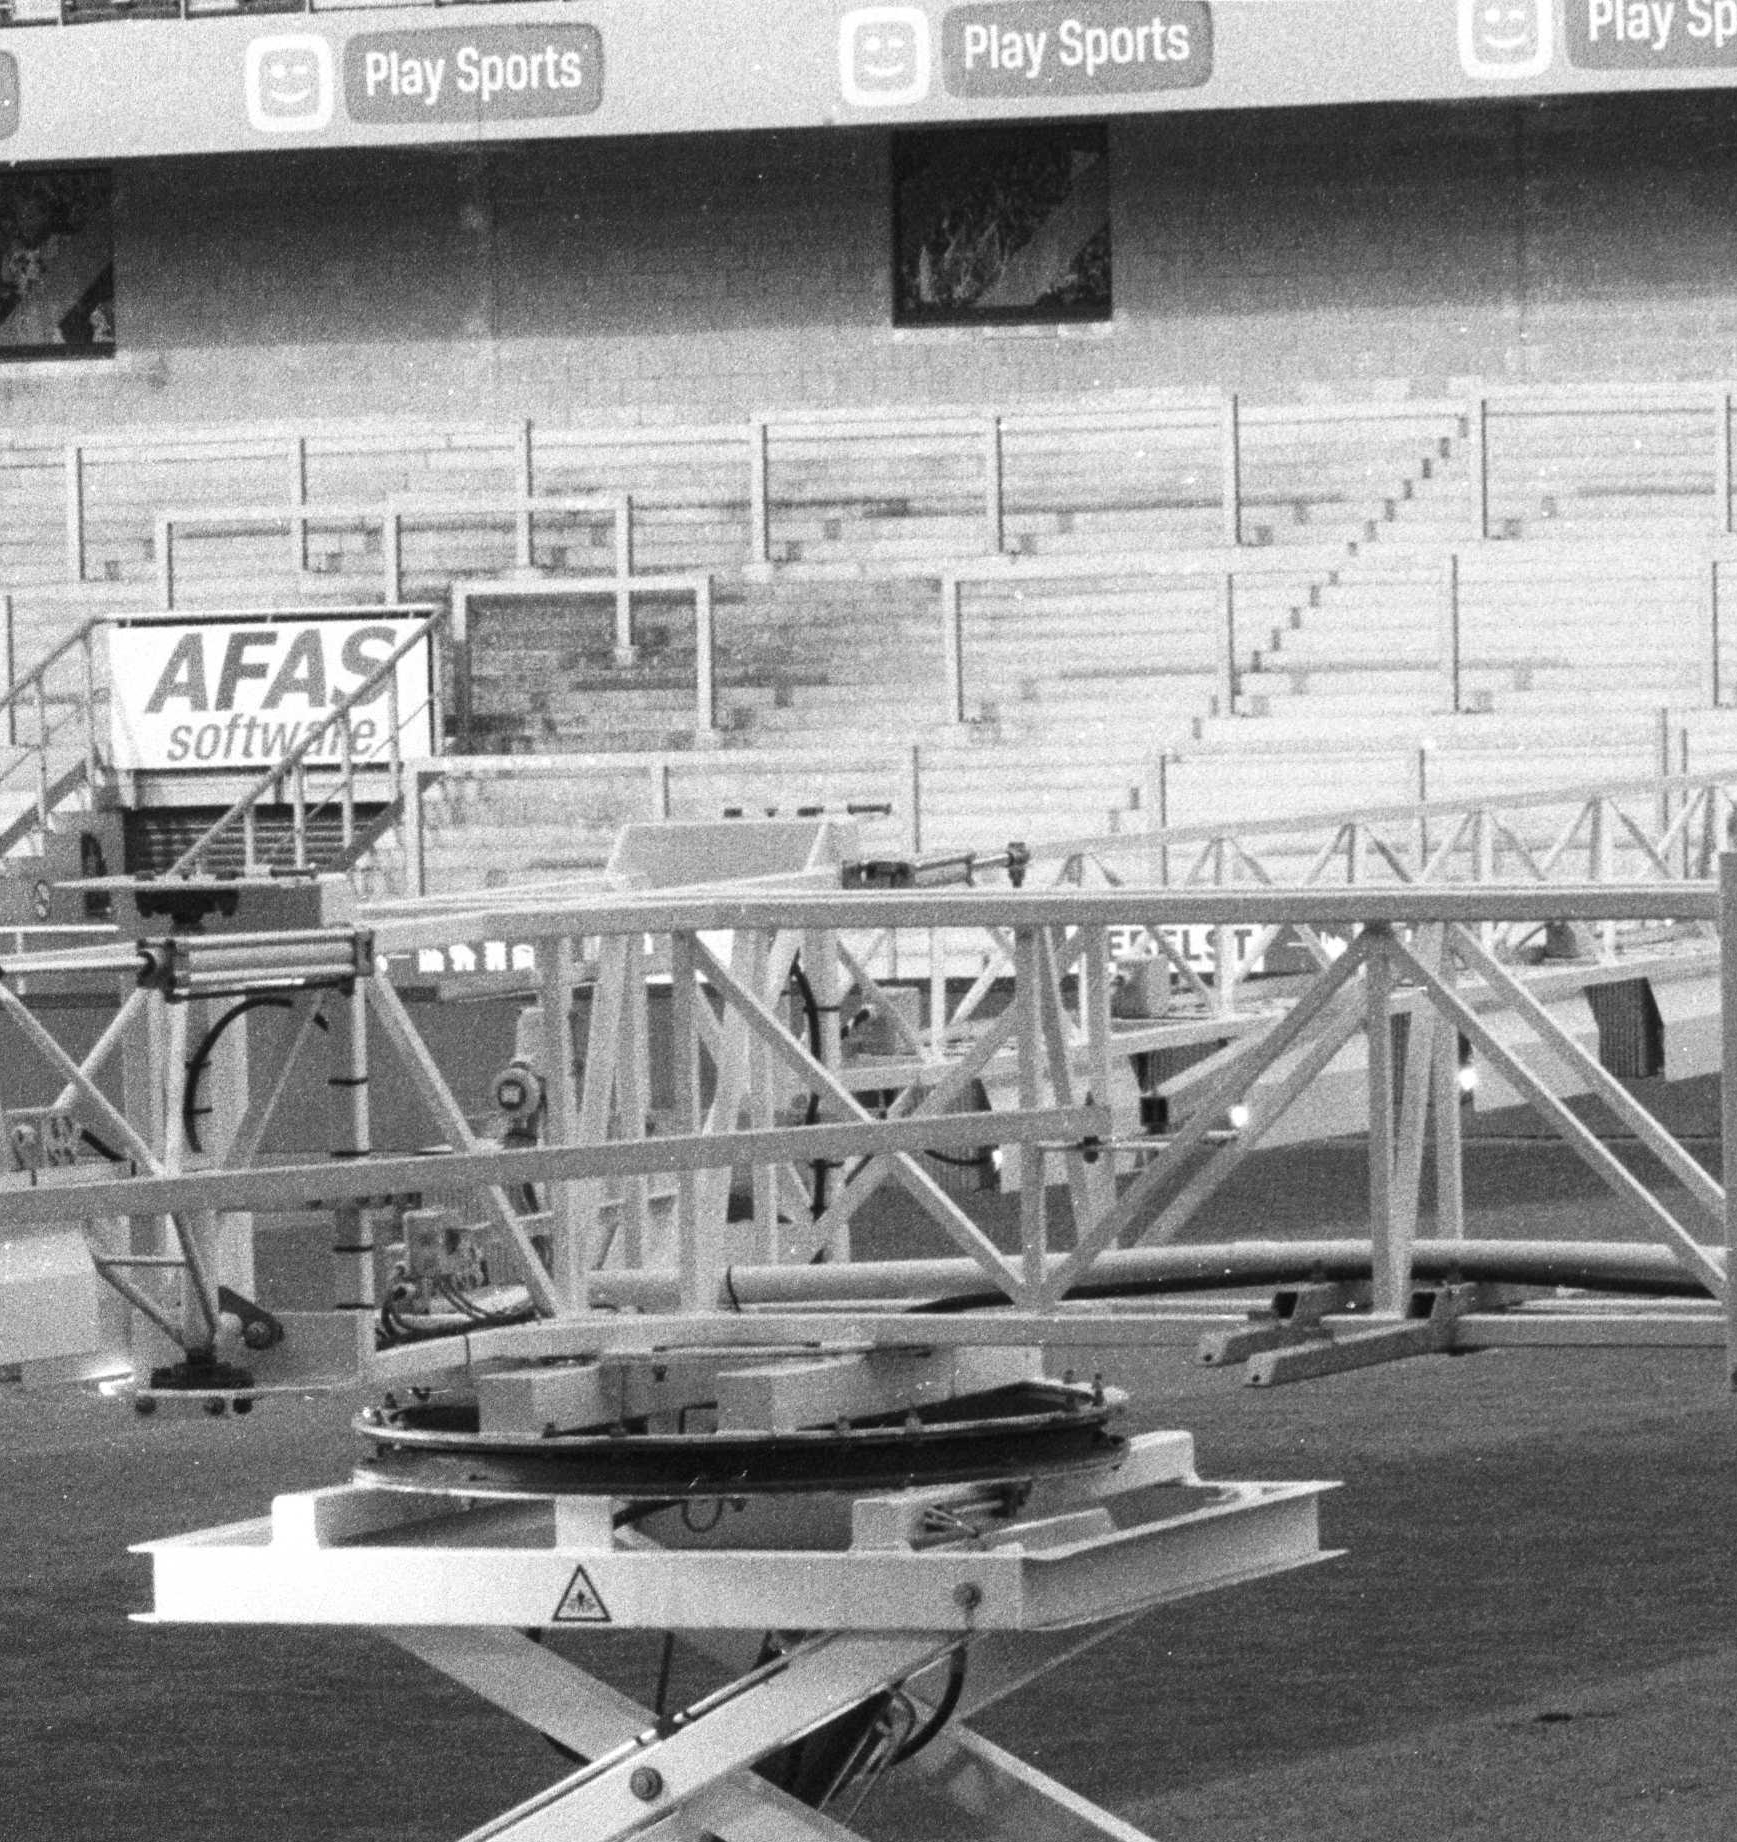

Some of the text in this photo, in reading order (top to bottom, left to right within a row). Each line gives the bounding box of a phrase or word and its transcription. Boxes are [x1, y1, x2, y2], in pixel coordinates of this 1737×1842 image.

[965, 18, 1190, 78] Play Sports
[1589, 0, 1674, 50] Play
[366, 45, 581, 105] Play Sports
[143, 625, 398, 714] AFAS
[166, 713, 377, 761] software
